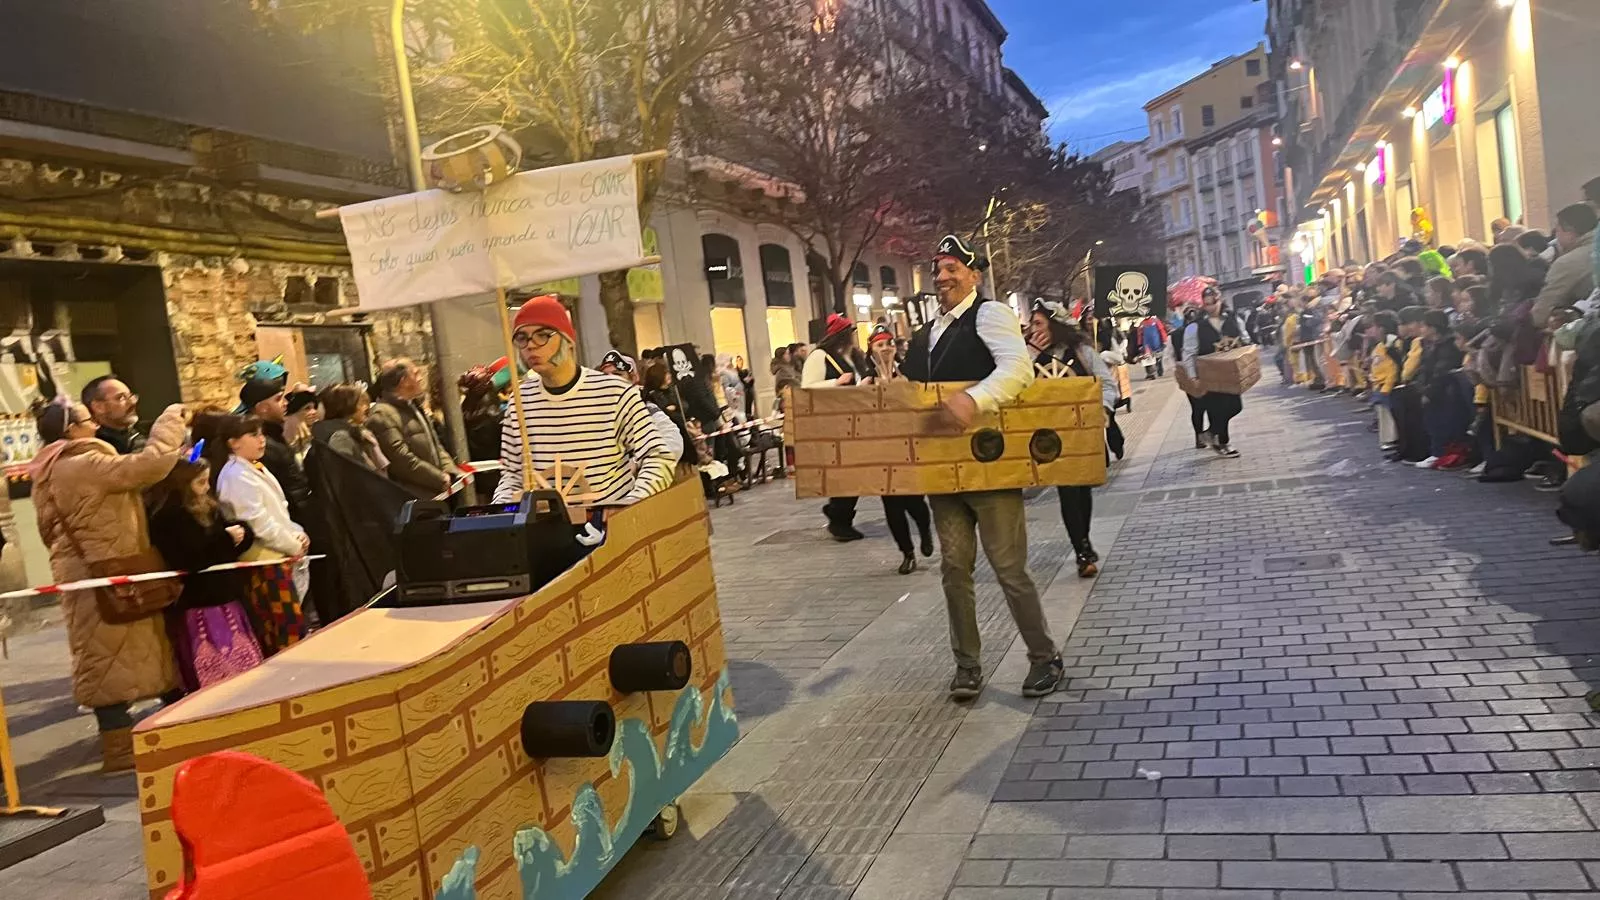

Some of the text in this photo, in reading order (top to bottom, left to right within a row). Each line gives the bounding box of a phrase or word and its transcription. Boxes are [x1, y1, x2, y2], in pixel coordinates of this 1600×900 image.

[361, 203, 398, 244] No
[408, 197, 459, 241] dejes
[470, 197, 535, 219] nunca
[543, 174, 573, 207] de
[369, 247, 401, 275] Solo
[481, 224, 539, 252] aprende
[546, 230, 555, 239] a
[567, 205, 627, 251] VOLAR
